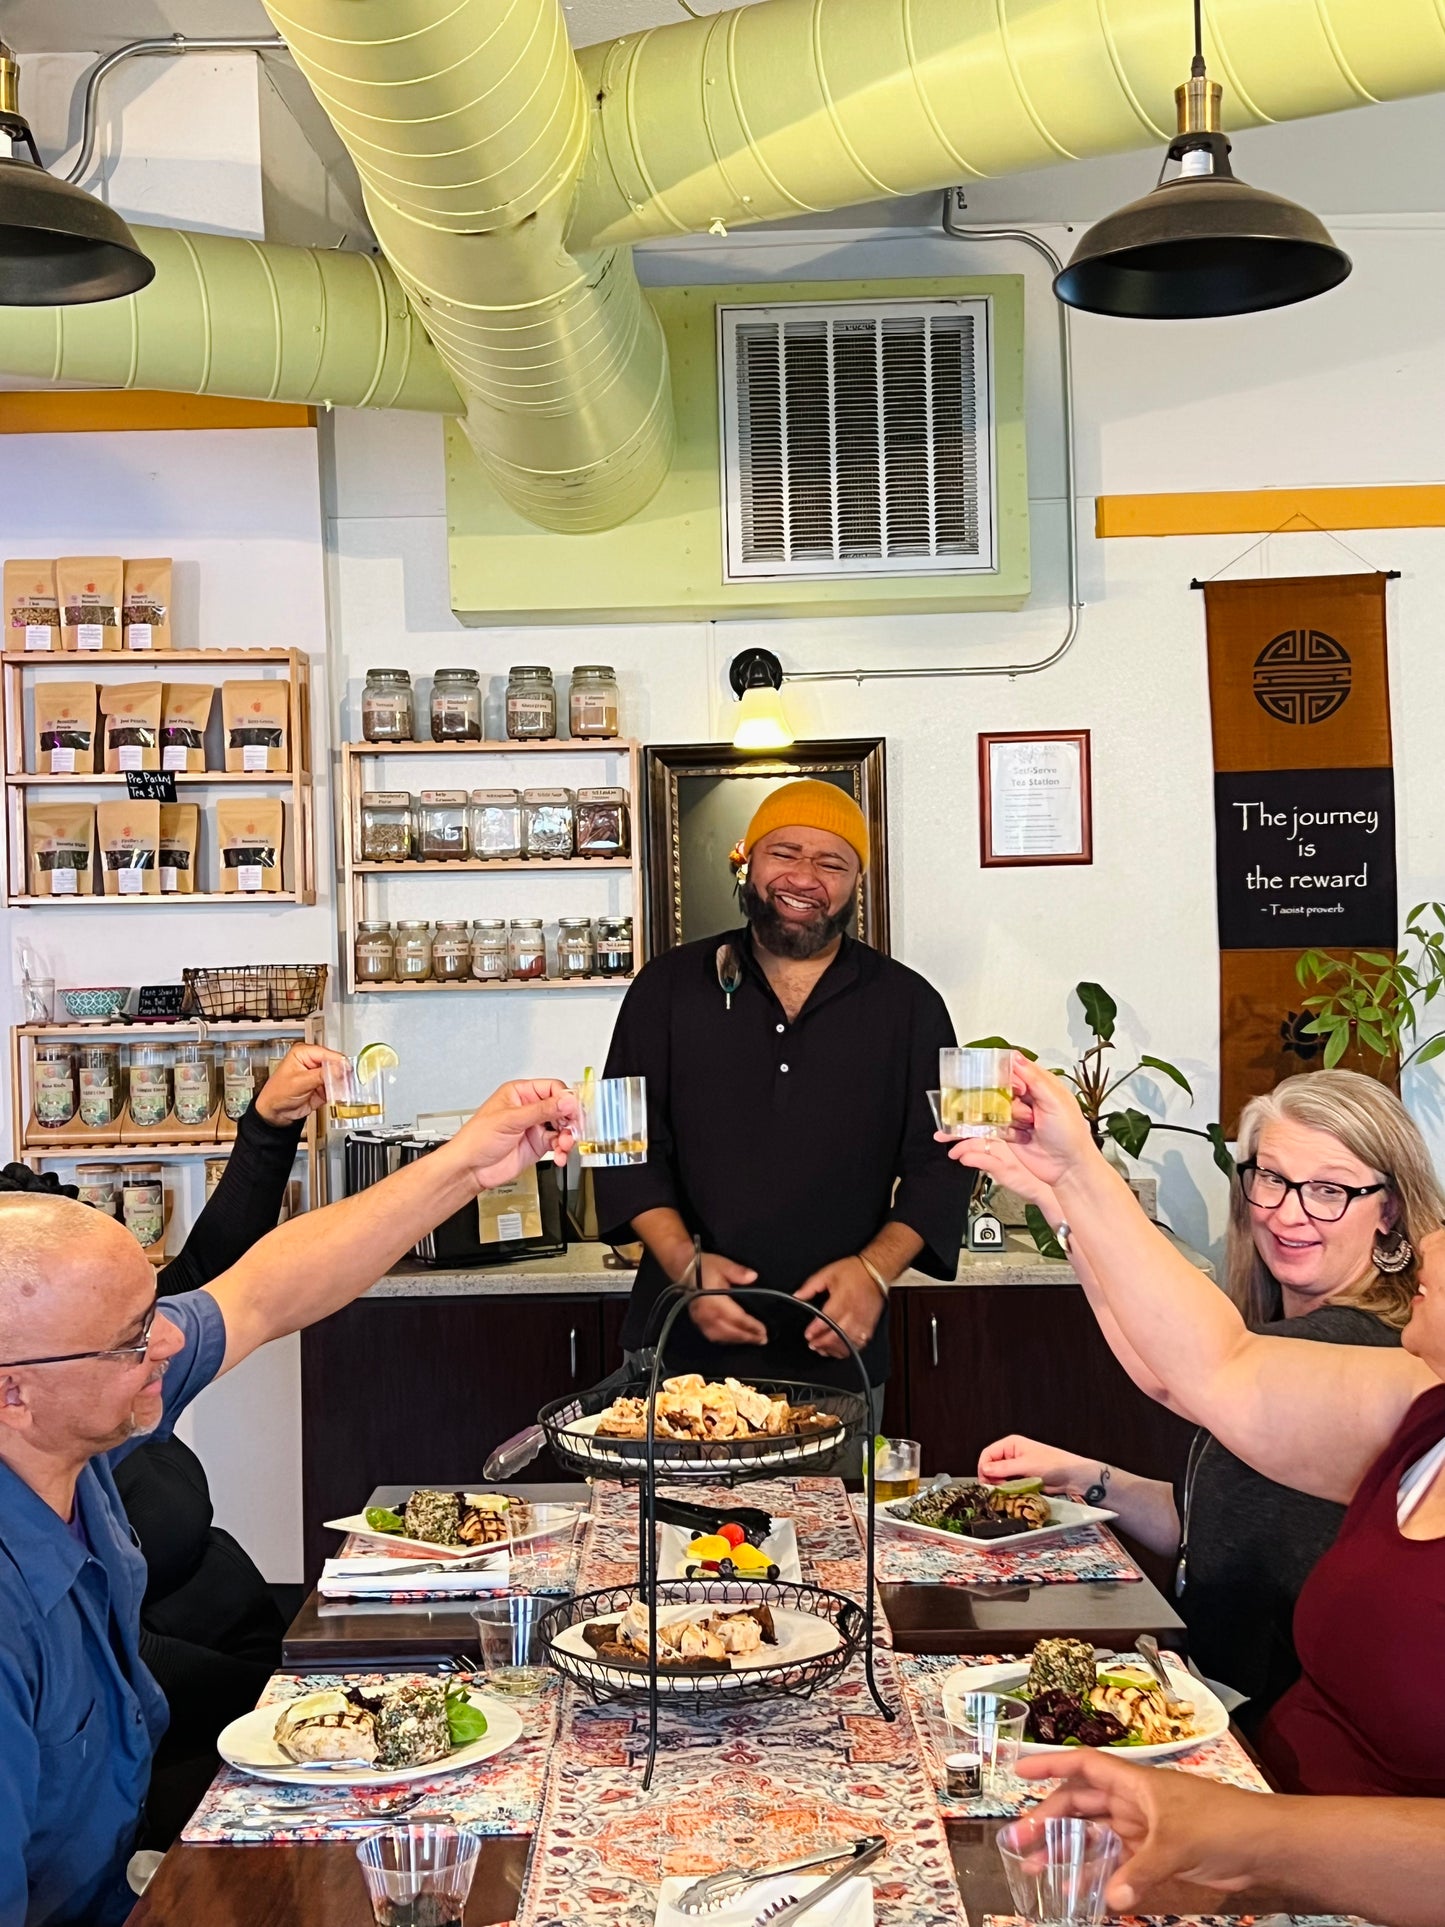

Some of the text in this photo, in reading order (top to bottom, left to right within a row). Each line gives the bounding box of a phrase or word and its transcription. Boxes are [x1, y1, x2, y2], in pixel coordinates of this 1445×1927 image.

[1013, 766, 1058, 775] Self-Serve
[127, 772, 143, 784] Pre
[1011, 778, 1060, 787] Tea Station
[130, 786, 145, 797] Tea
[1232, 801, 1379, 841] The journey
[1298, 838, 1317, 857] is
[1246, 862, 1368, 890] the reward
[1269, 904, 1305, 916] Taoist
[1306, 902, 1345, 918] proverb
